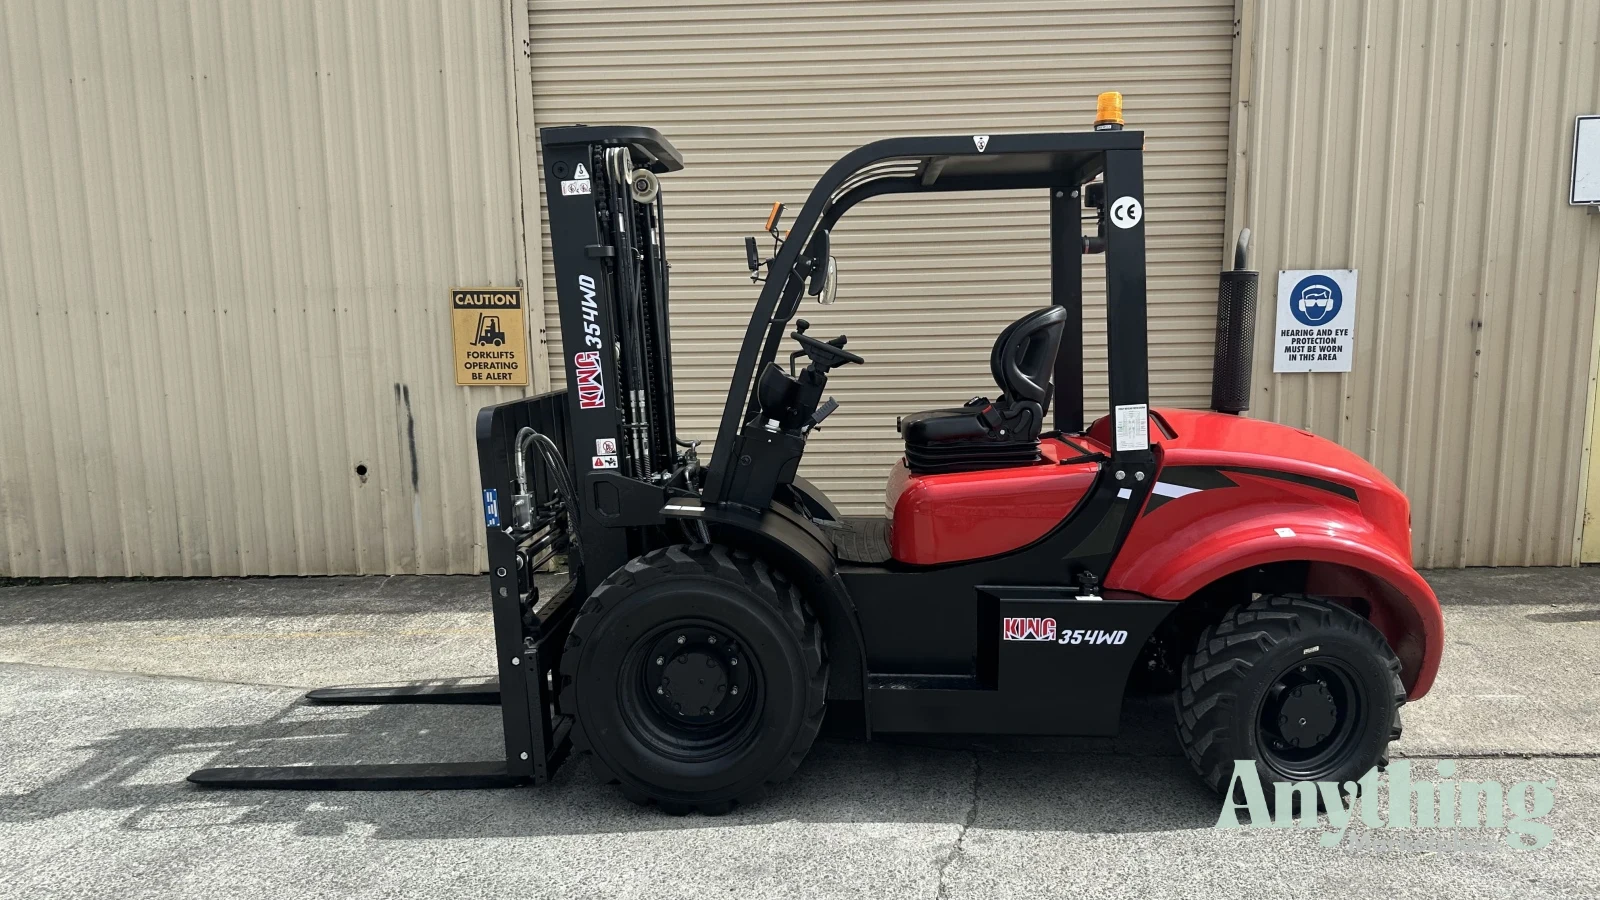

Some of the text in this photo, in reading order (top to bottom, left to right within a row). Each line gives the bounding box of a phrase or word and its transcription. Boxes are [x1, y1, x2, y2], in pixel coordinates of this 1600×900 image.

[1114, 204, 1136, 221] CE
[455, 293, 517, 306] CAUTION
[1281, 329, 1314, 337] HEARING
[1335, 328, 1349, 336] EYE
[574, 274, 606, 410] KING 354WD
[1291, 337, 1337, 345] PROTECTION
[1284, 345, 1343, 353] MUST BE WORN
[467, 351, 515, 359] FORKLIFTS
[1299, 353, 1315, 361] THIS
[1317, 353, 1337, 361] AREA
[464, 361, 519, 370] OPERATING
[471, 372, 512, 380] BE ALERT
[1003, 617, 1128, 645] KING 354WD
